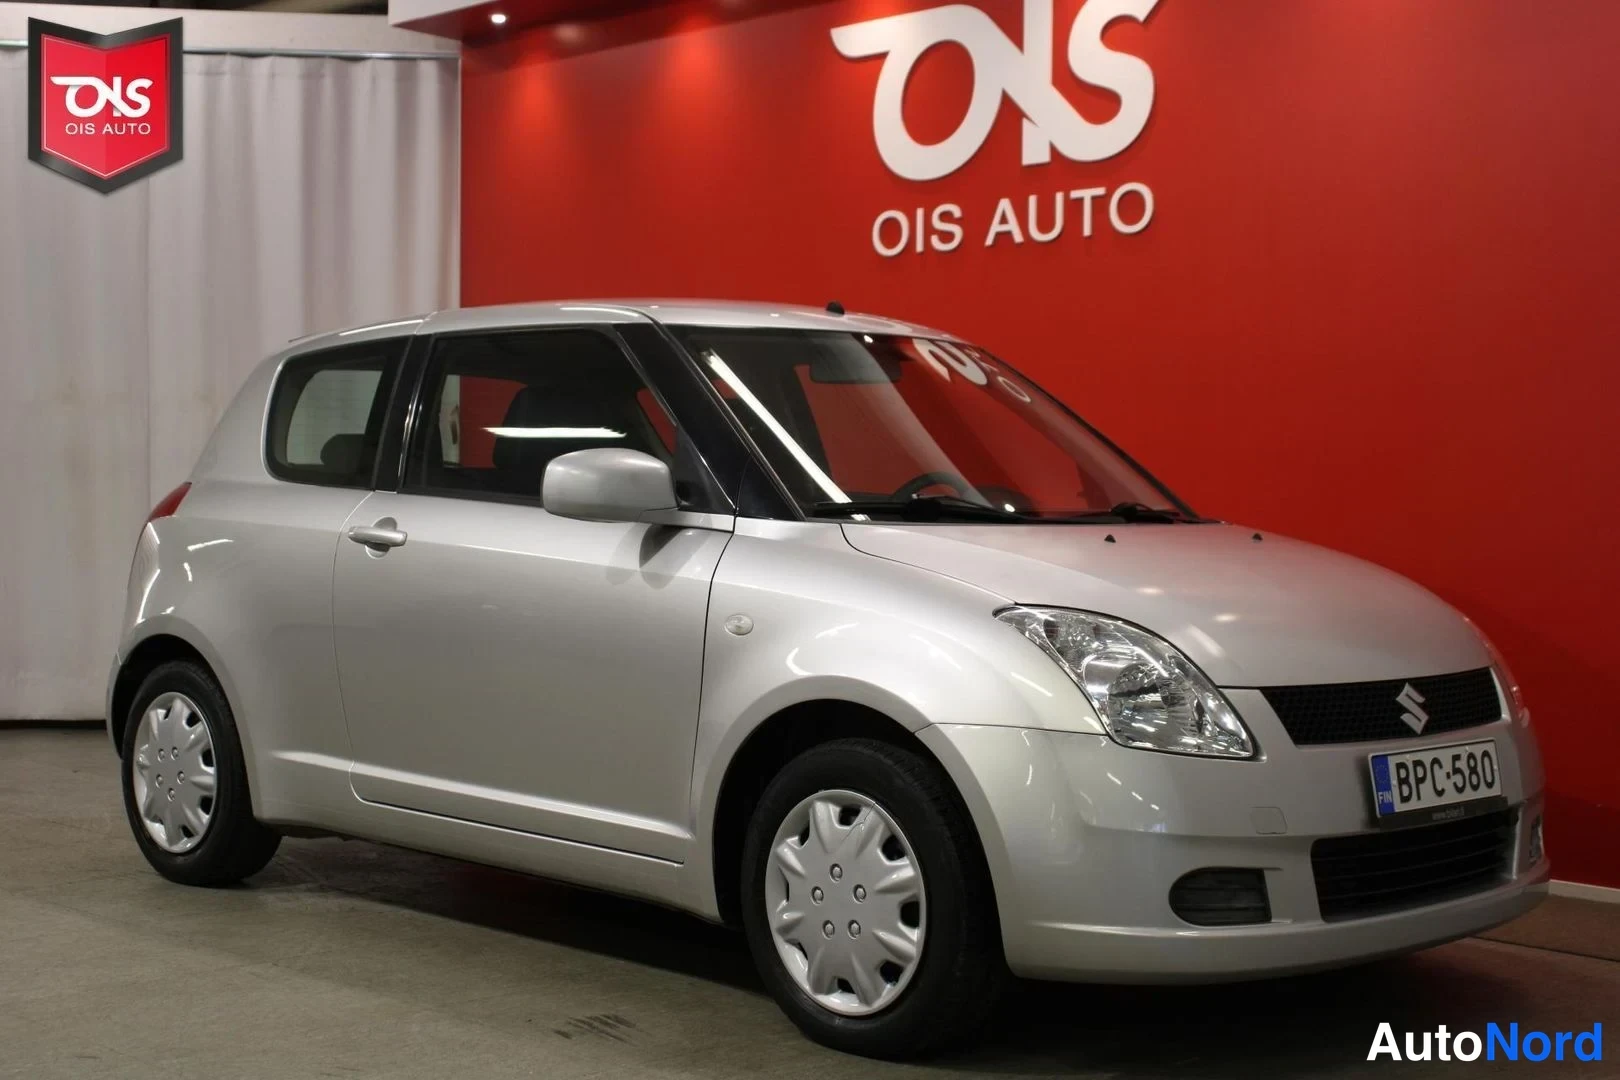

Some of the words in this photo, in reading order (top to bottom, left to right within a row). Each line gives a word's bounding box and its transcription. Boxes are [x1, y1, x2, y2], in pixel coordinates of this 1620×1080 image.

[872, 203, 963, 257] OIS
[984, 182, 1154, 247] AUTO
[1377, 791, 1393, 805] FIN
